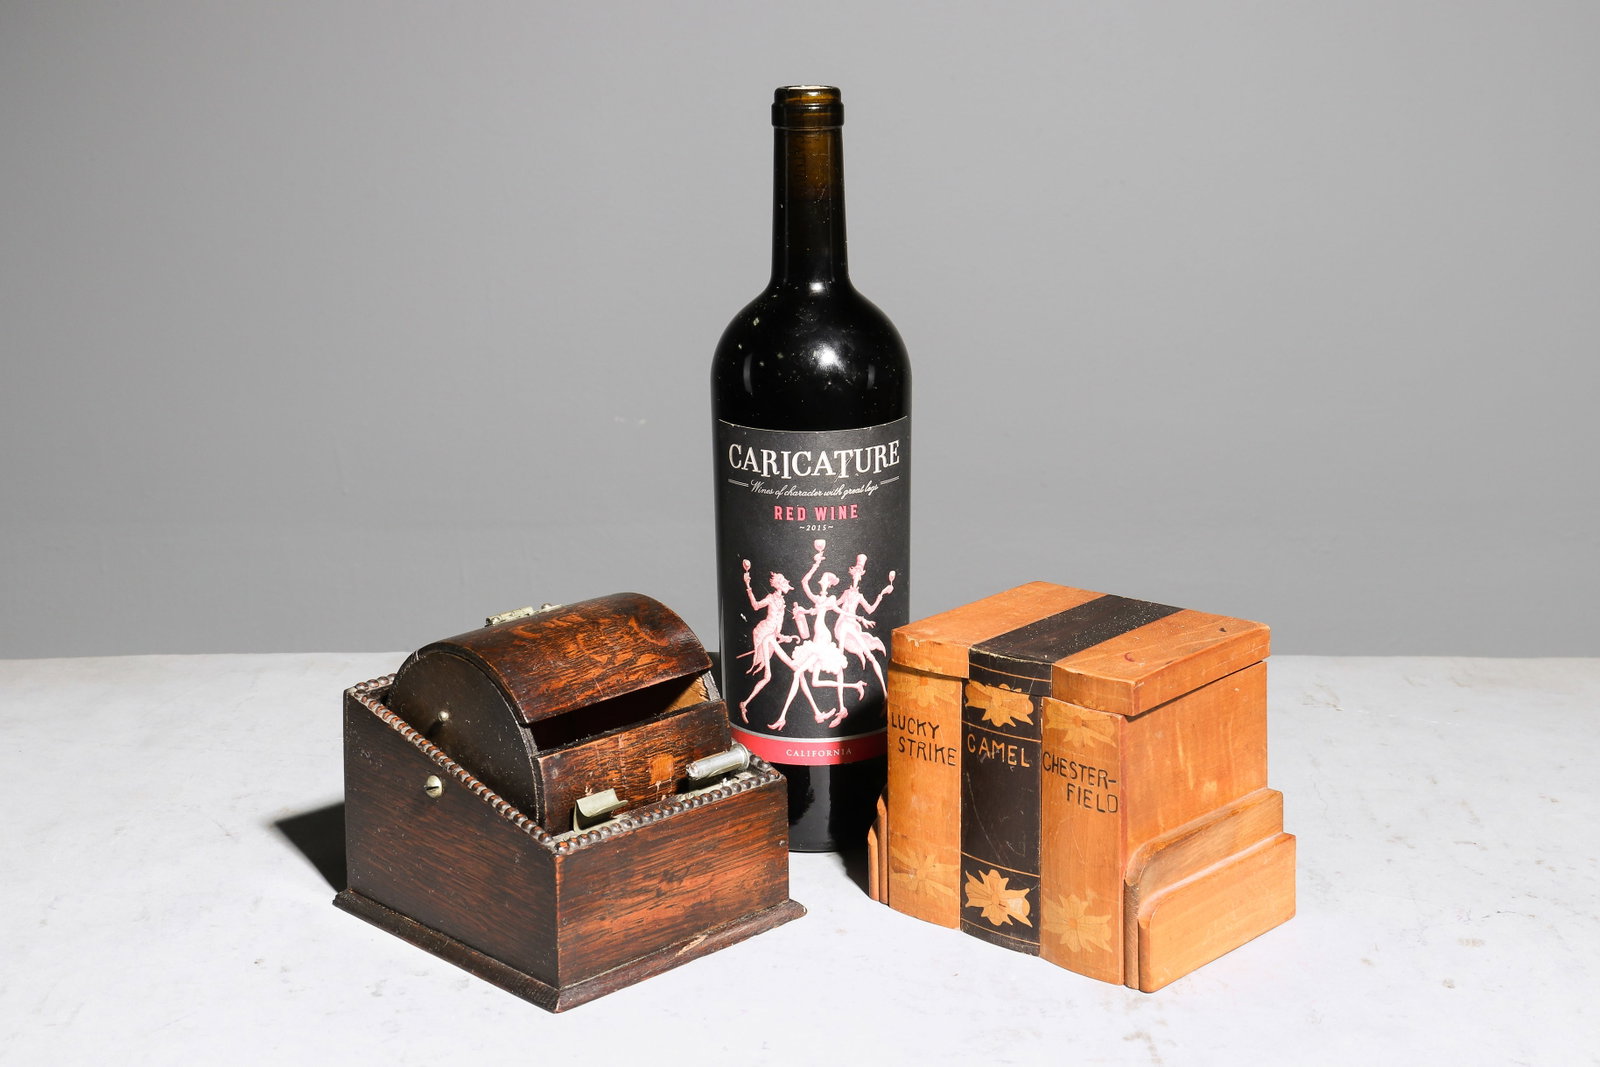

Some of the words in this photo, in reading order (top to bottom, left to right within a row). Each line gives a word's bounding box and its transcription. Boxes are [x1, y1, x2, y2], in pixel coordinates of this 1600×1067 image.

[728, 439, 900, 479] CARICATURE
[750, 479, 774, 495] Wines
[774, 485, 784, 499] of
[784, 485, 823, 497] character
[823, 484, 842, 496] with
[841, 484, 864, 499] great
[864, 480, 879, 497] legs
[774, 505, 806, 521] RED
[814, 504, 859, 521] WINE
[891, 711, 940, 739] LUCKY
[786, 748, 852, 758] CALIFORNIA
[898, 736, 958, 767] STRIKE
[967, 733, 1031, 768] CAMEL
[1042, 751, 1118, 791] CHESTER-
[1066, 782, 1119, 814] FIELD
